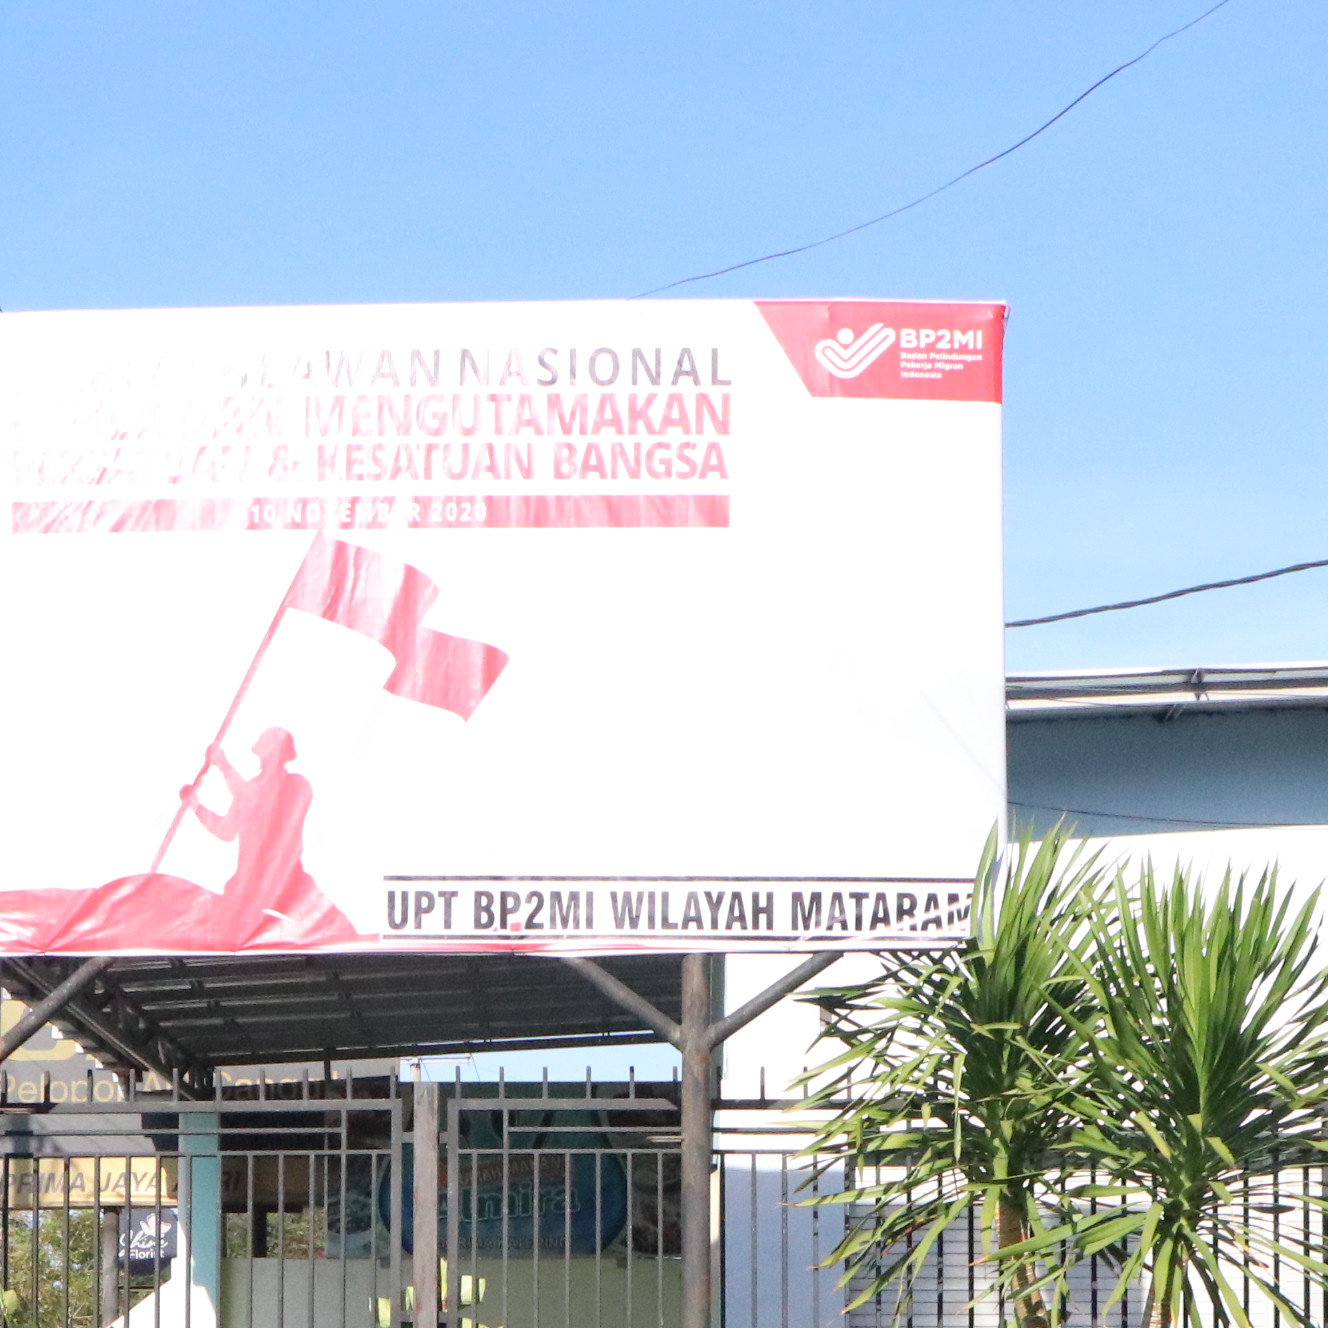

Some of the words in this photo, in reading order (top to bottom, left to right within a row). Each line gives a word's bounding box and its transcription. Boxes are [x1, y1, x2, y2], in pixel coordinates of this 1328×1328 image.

[899, 327, 983, 350] BP2MI
[459, 346, 733, 388] NASIONAL
[900, 351, 928, 361] Badan
[900, 370, 943, 380] Indonesia
[304, 392, 733, 438] MENGUTAMAKAN
[317, 441, 535, 481] KESATUAN
[552, 440, 730, 480] BANGSA
[286, 502, 421, 524] NOEMBR
[429, 501, 487, 522] 2020
[385, 890, 459, 931] UPT
[472, 890, 594, 931] BP2MI
[610, 890, 774, 931] WILAYAH
[791, 891, 973, 933] MATARAM
[129, 1248, 165, 1260] Florit
